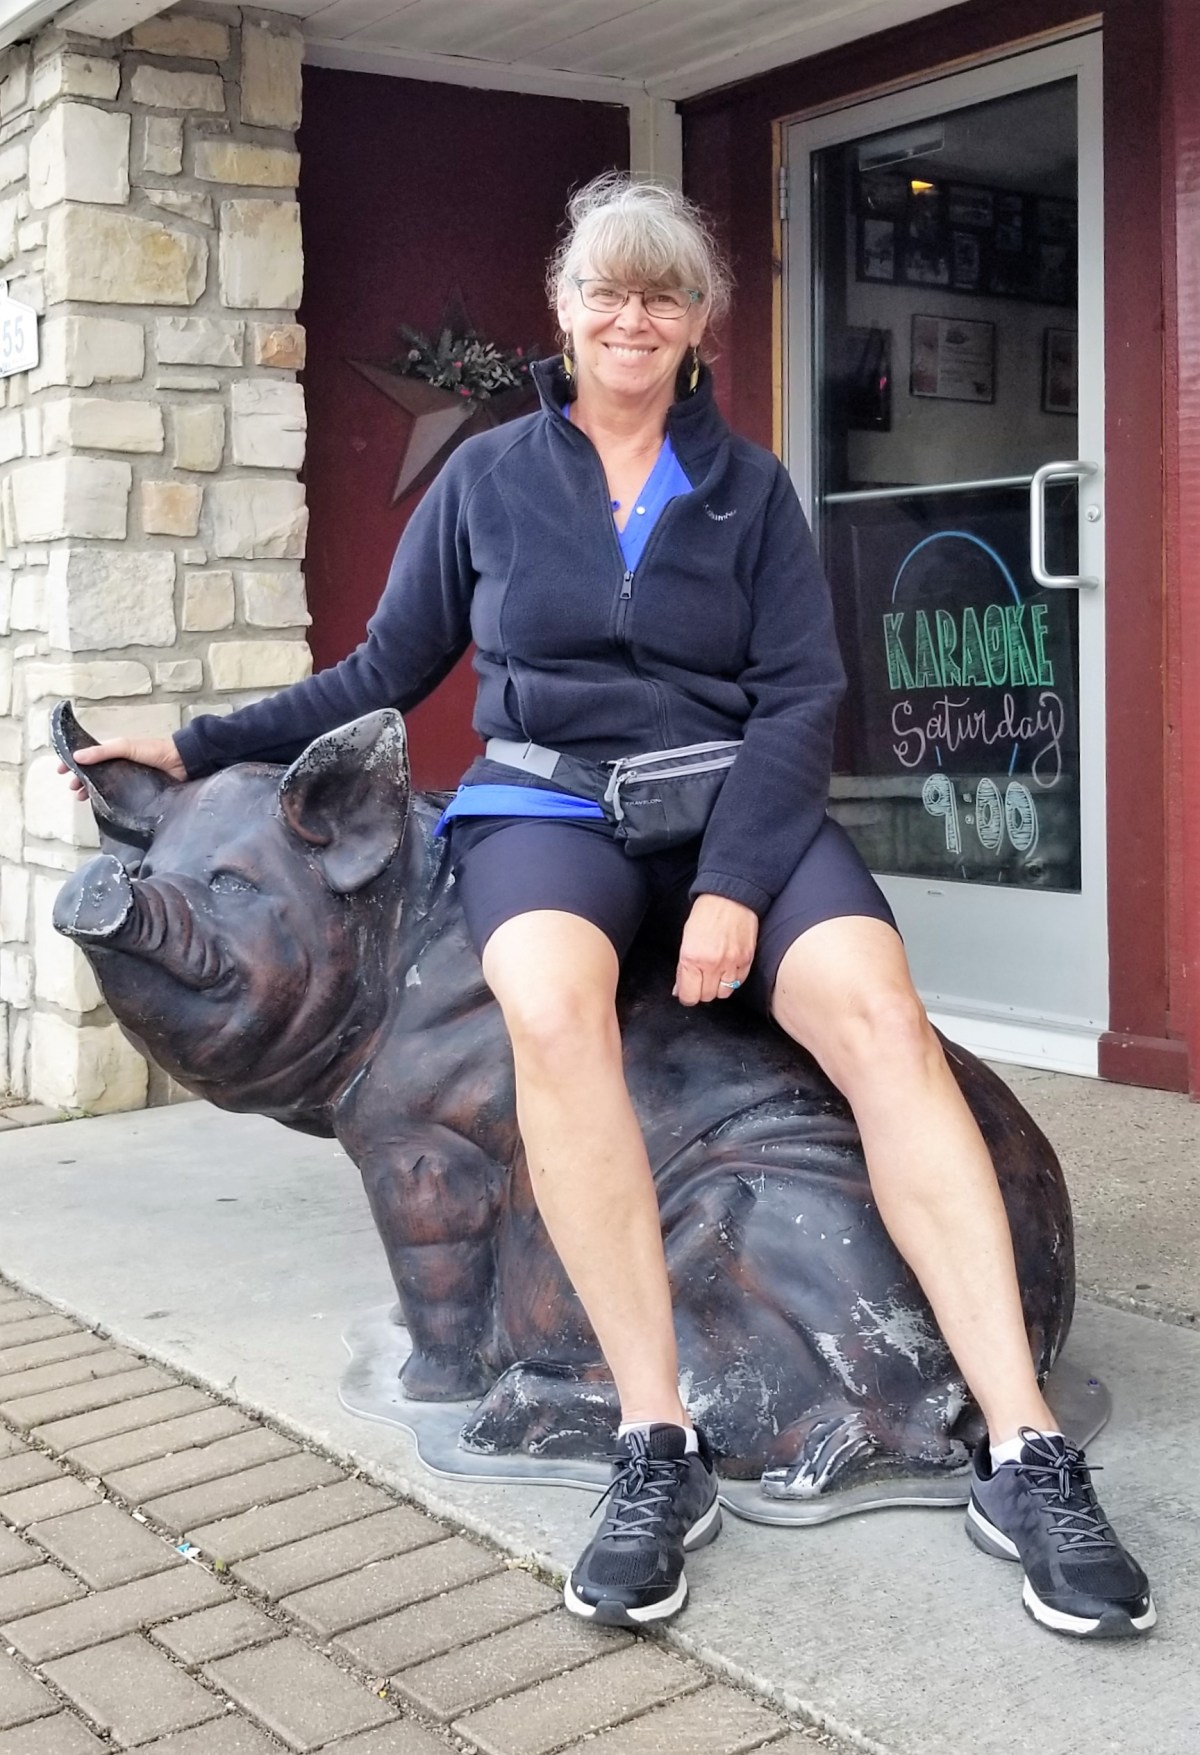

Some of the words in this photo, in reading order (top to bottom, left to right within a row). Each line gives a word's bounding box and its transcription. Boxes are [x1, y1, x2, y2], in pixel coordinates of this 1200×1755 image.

[883, 603, 1055, 690] KARAOKE
[892, 691, 1065, 789] Saturday
[922, 773, 1040, 858] 9:00
